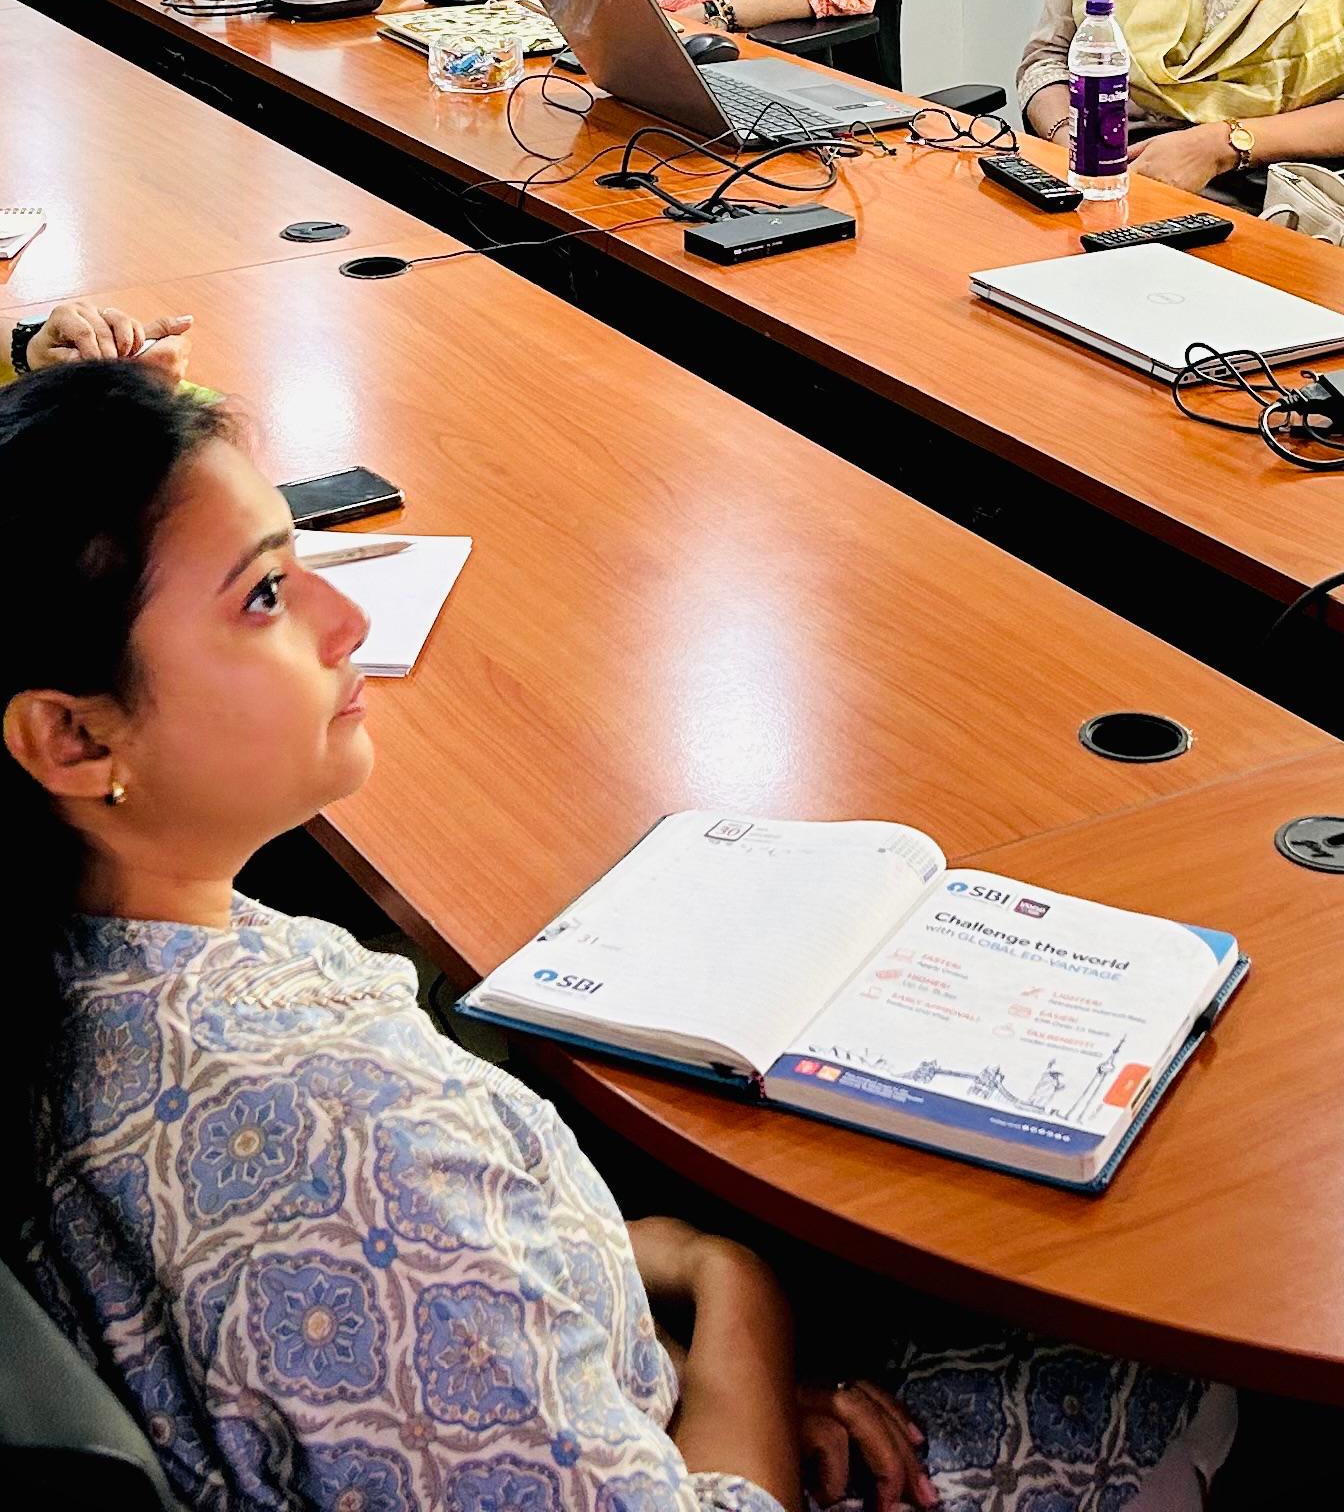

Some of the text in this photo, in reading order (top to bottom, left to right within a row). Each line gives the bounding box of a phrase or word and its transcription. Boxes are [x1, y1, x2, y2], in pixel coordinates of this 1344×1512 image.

[968, 886, 1011, 906] SBI
[925, 923, 956, 939] with
[957, 930, 1016, 957] GLOBAL
[934, 911, 1131, 972] Challenge the world
[555, 974, 604, 995] SBI
